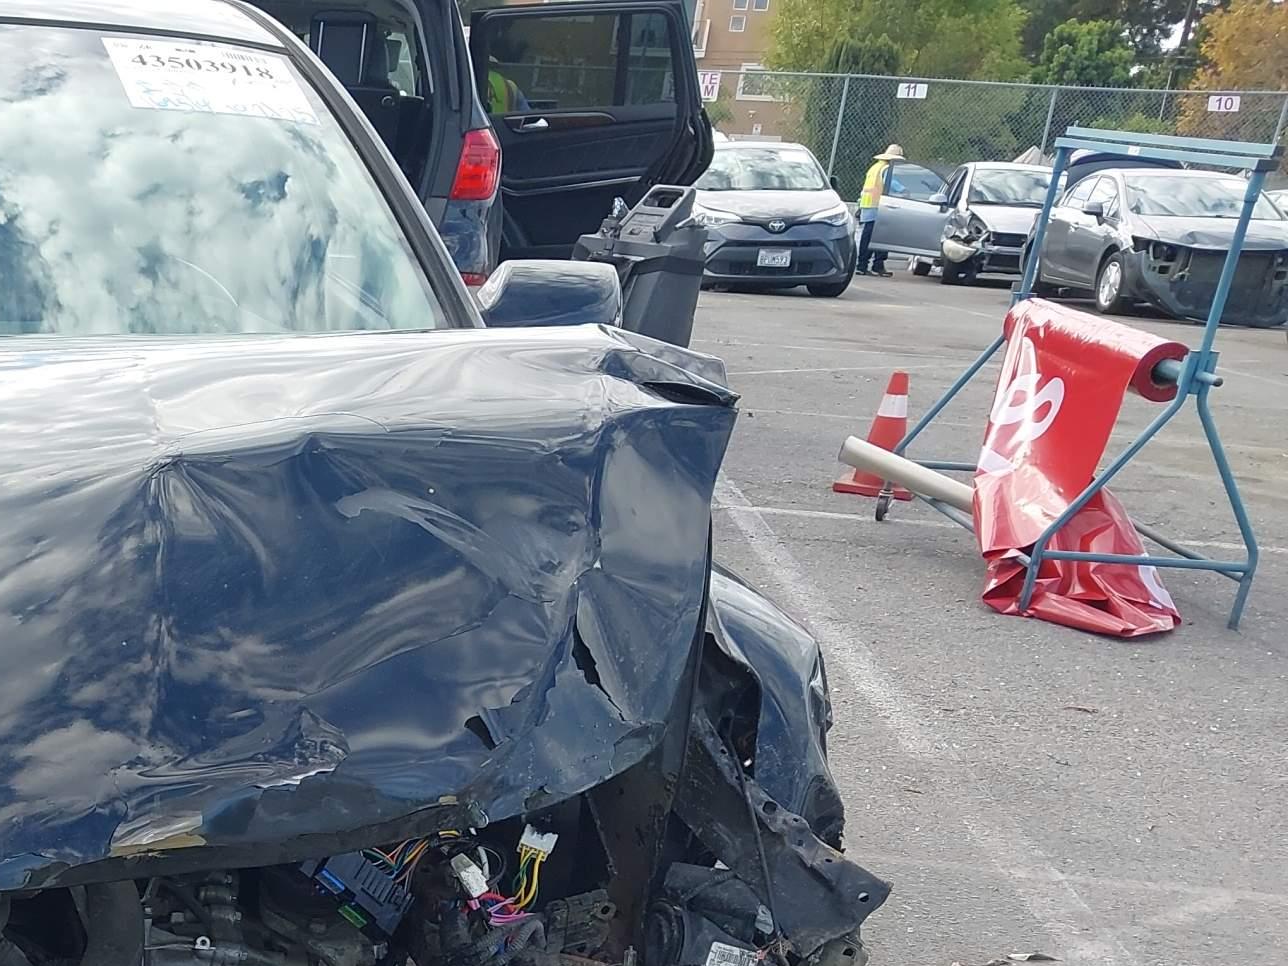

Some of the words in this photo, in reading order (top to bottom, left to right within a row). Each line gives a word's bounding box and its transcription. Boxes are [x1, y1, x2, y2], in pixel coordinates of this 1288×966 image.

[131, 54, 274, 80] 43503918
[904, 84, 917, 97] 11
[1215, 97, 1234, 110] 10
